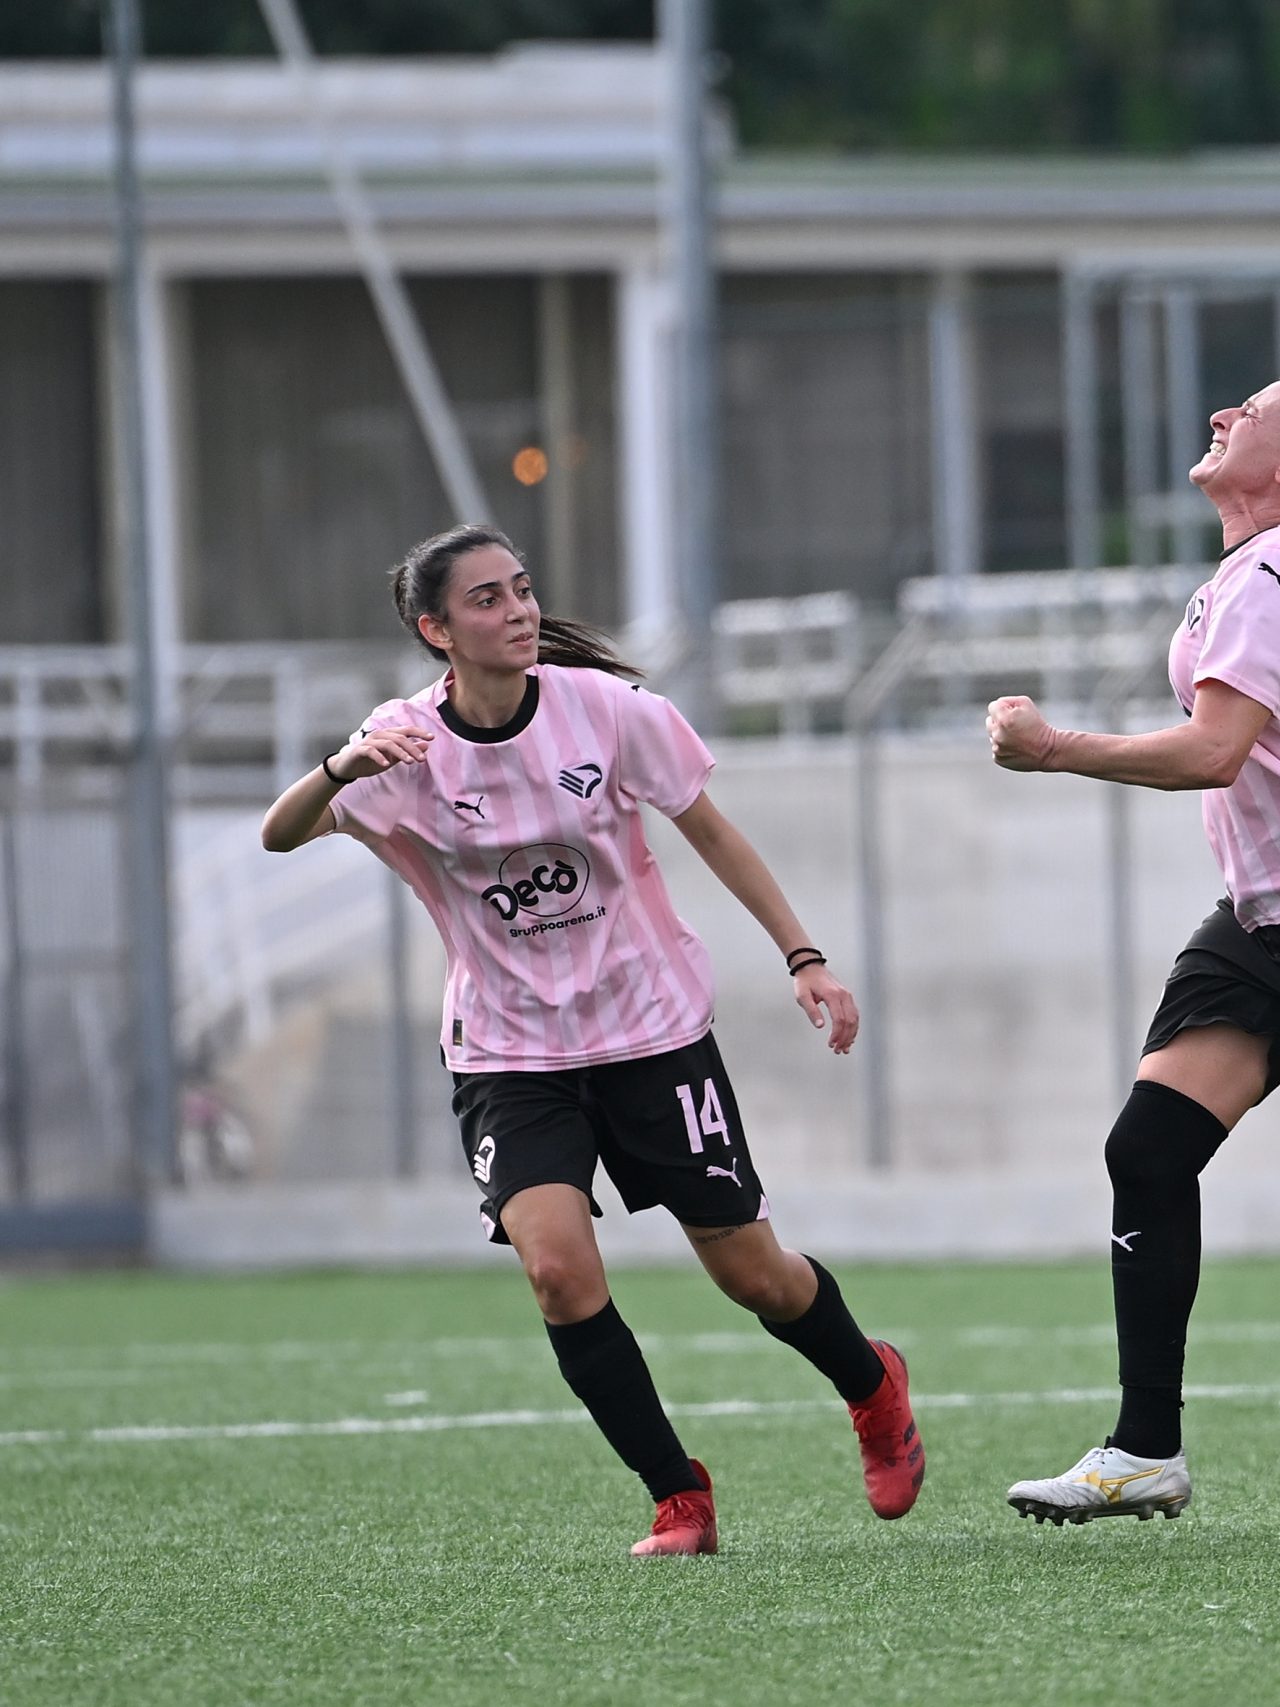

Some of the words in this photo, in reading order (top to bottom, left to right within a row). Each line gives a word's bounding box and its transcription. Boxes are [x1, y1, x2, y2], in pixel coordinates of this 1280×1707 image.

[481, 859, 578, 921] Decò
[509, 905, 606, 938] gruppoarena.it
[675, 1077, 731, 1154] 14
